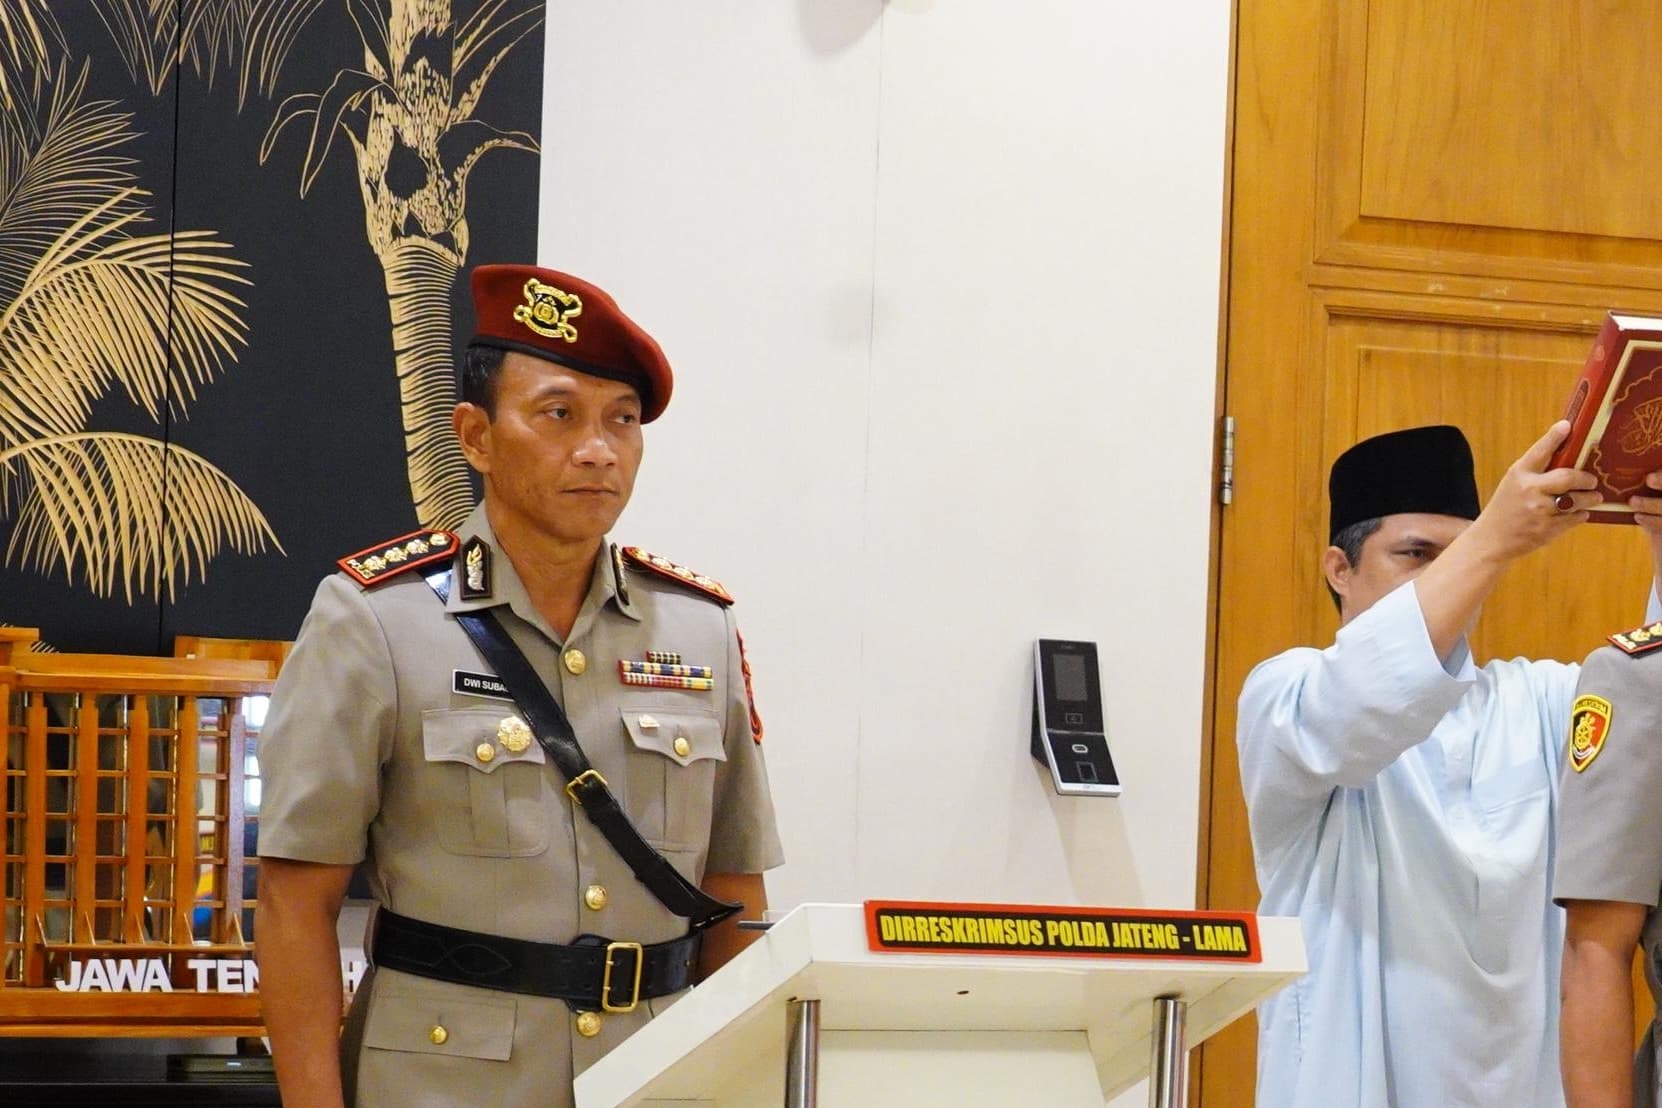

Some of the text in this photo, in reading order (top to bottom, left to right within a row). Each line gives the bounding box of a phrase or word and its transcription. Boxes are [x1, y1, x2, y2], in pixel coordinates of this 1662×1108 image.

[463, 678, 509, 692] DWI SUBA
[880, 915, 1044, 945] DIRRESKRIMSUS
[1047, 920, 1110, 947] POLDA
[1112, 922, 1180, 949] JATENG
[1193, 926, 1247, 951] LAMA
[55, 959, 173, 993] JAWA
